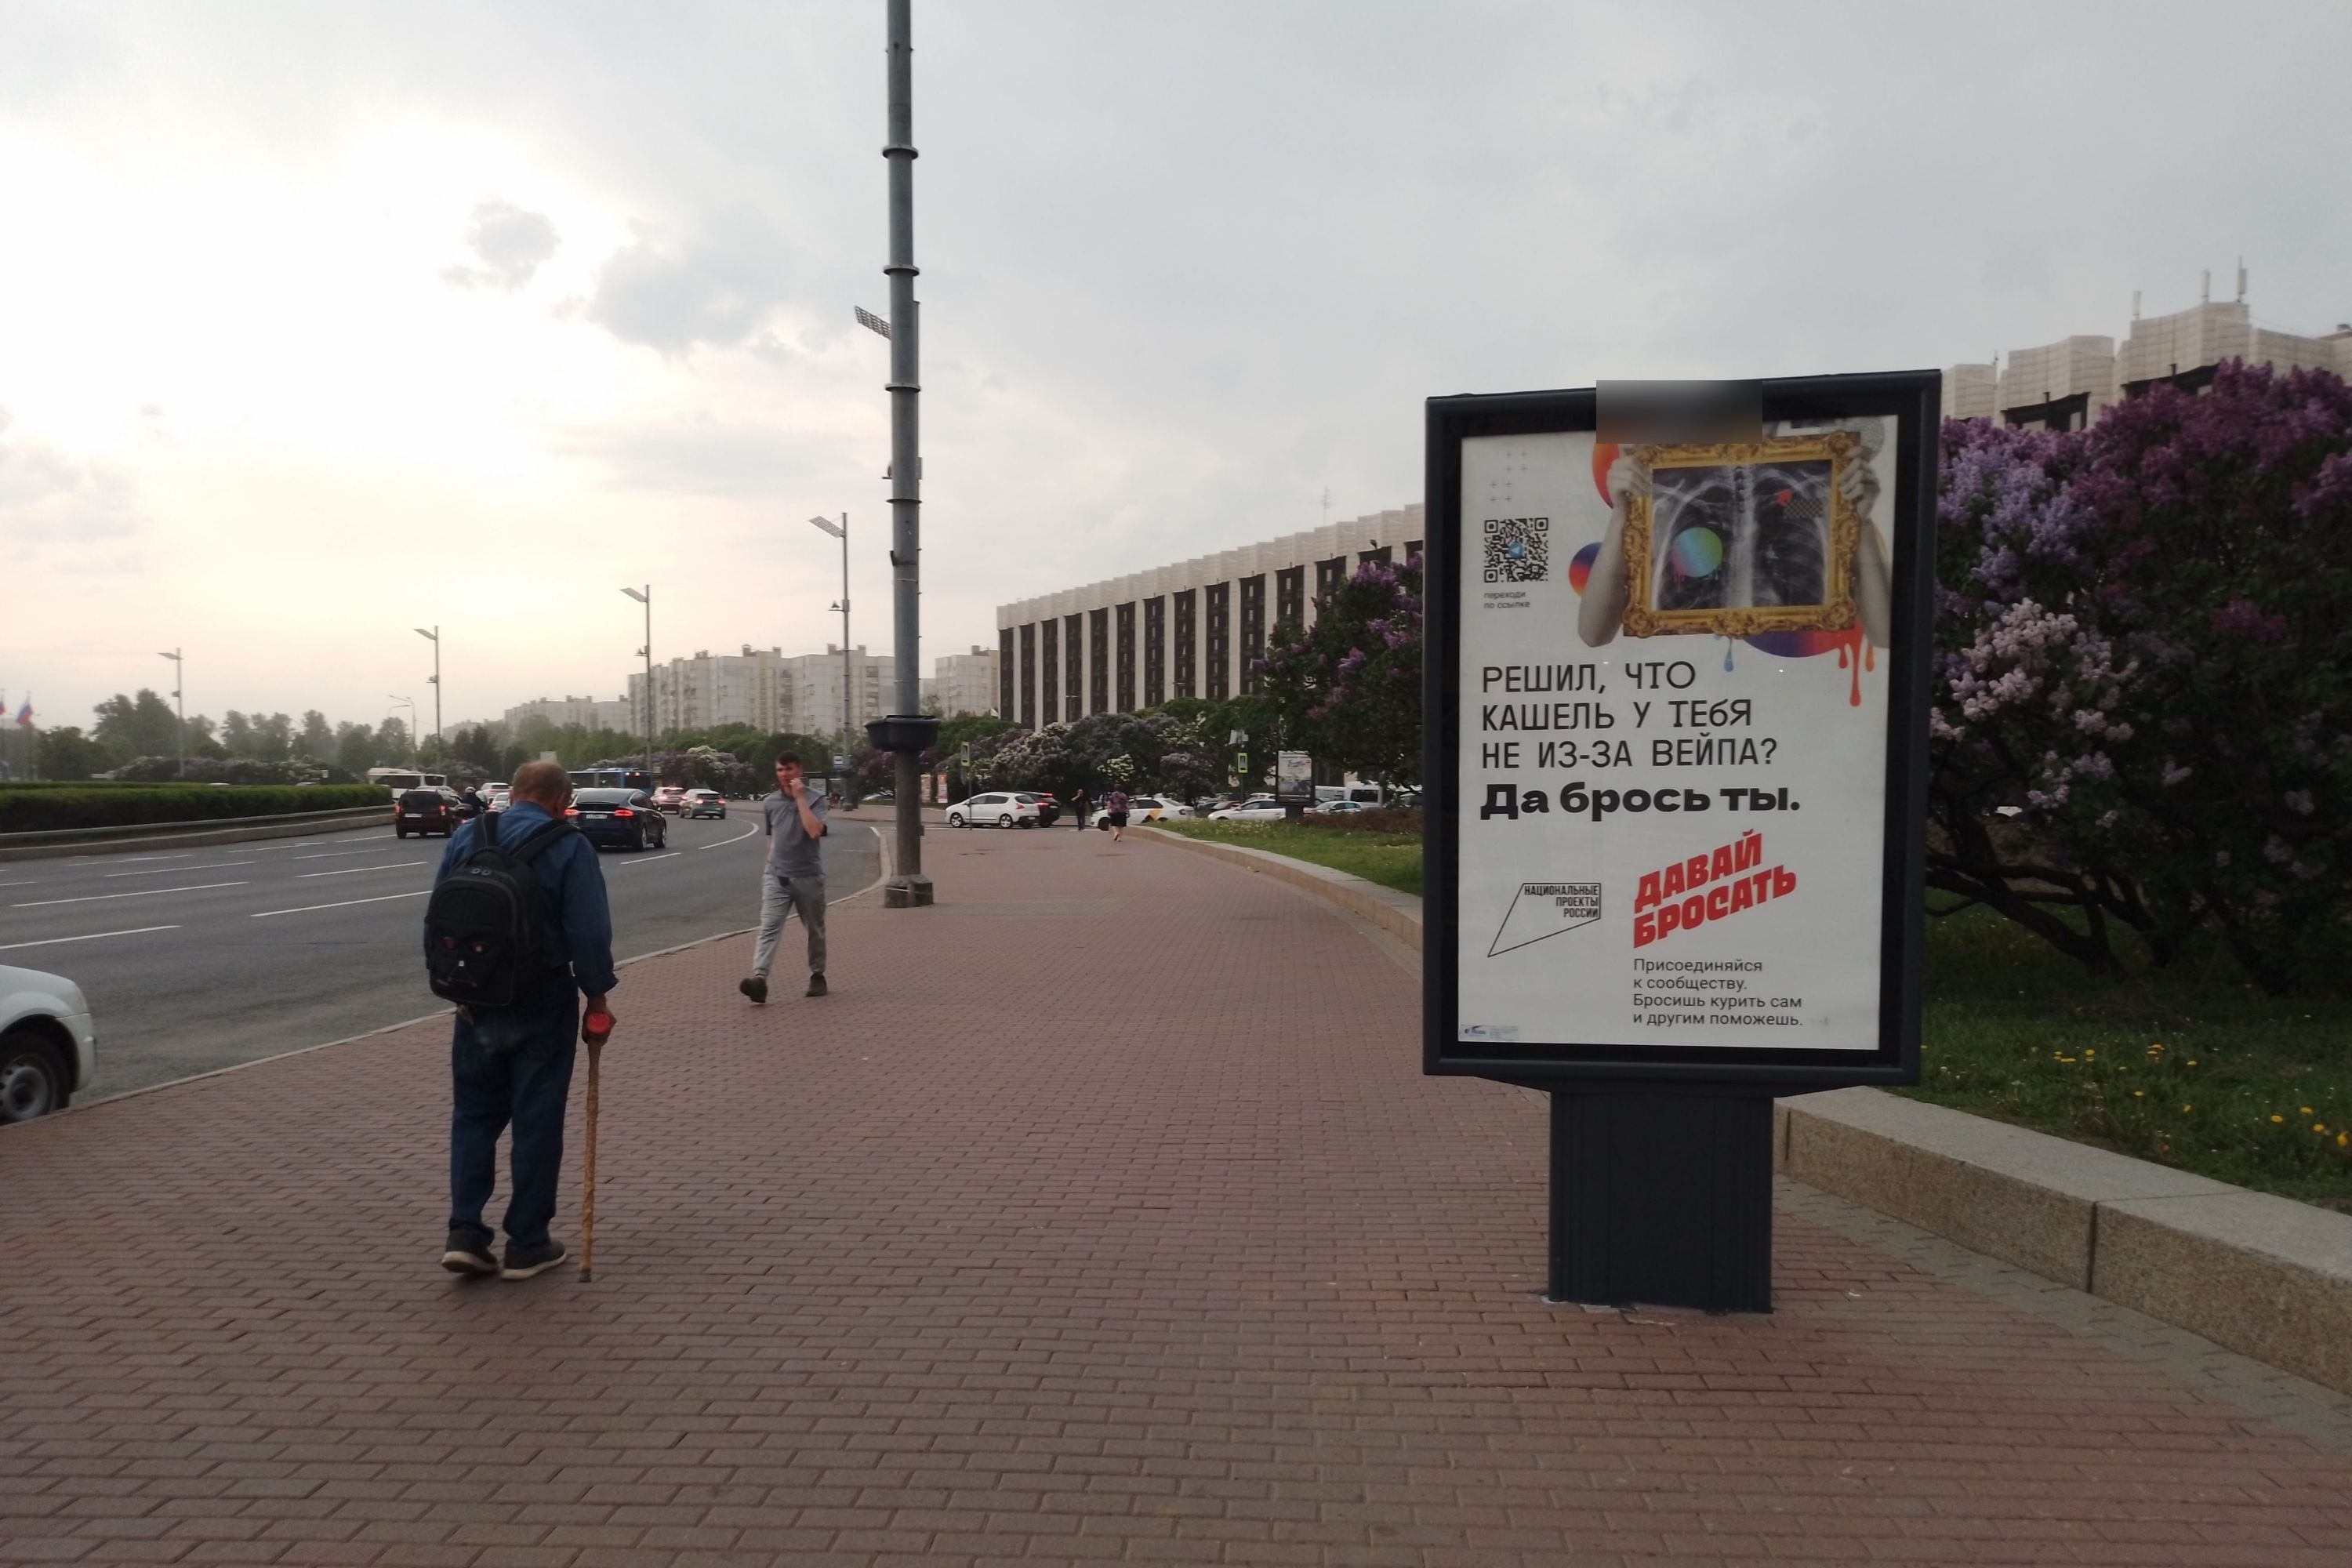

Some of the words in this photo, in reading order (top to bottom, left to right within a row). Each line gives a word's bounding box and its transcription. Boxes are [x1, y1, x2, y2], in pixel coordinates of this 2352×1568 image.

[1483, 664, 1606, 694] РЕШИЛ,
[1625, 661, 1696, 689] ЧТО
[1483, 702, 1615, 731] КАШЕЛЬ
[1633, 701, 1651, 728] У
[1483, 742, 1520, 769] НЕ
[1538, 740, 1632, 768] ИЗ-ЗА
[1652, 732, 1777, 766] ВЕЙПА?
[1480, 783, 1549, 820] Да
[1559, 782, 1711, 822] брось
[1719, 787, 1801, 811] ты.
[1634, 829, 1762, 914] ДАВАЙ
[1524, 885, 1599, 896] НАЦИОНАЛЬНЫЕ
[1555, 896, 1599, 906] ПРОЕКТЫ
[1633, 865, 1797, 949] БРОСАТЬ
[1563, 908, 1599, 917] РОССИИ
[1633, 958, 1762, 974] Присоединяйся
[1633, 978, 1642, 989] к
[1647, 976, 1748, 993] сообществу.
[1633, 993, 1705, 1008] Бросишь
[1710, 996, 1766, 1010] курить
[1770, 997, 1802, 1007] сам
[1633, 1014, 1642, 1023] и
[1646, 1014, 1704, 1026] другим
[1710, 1014, 1803, 1025] поможешь.
